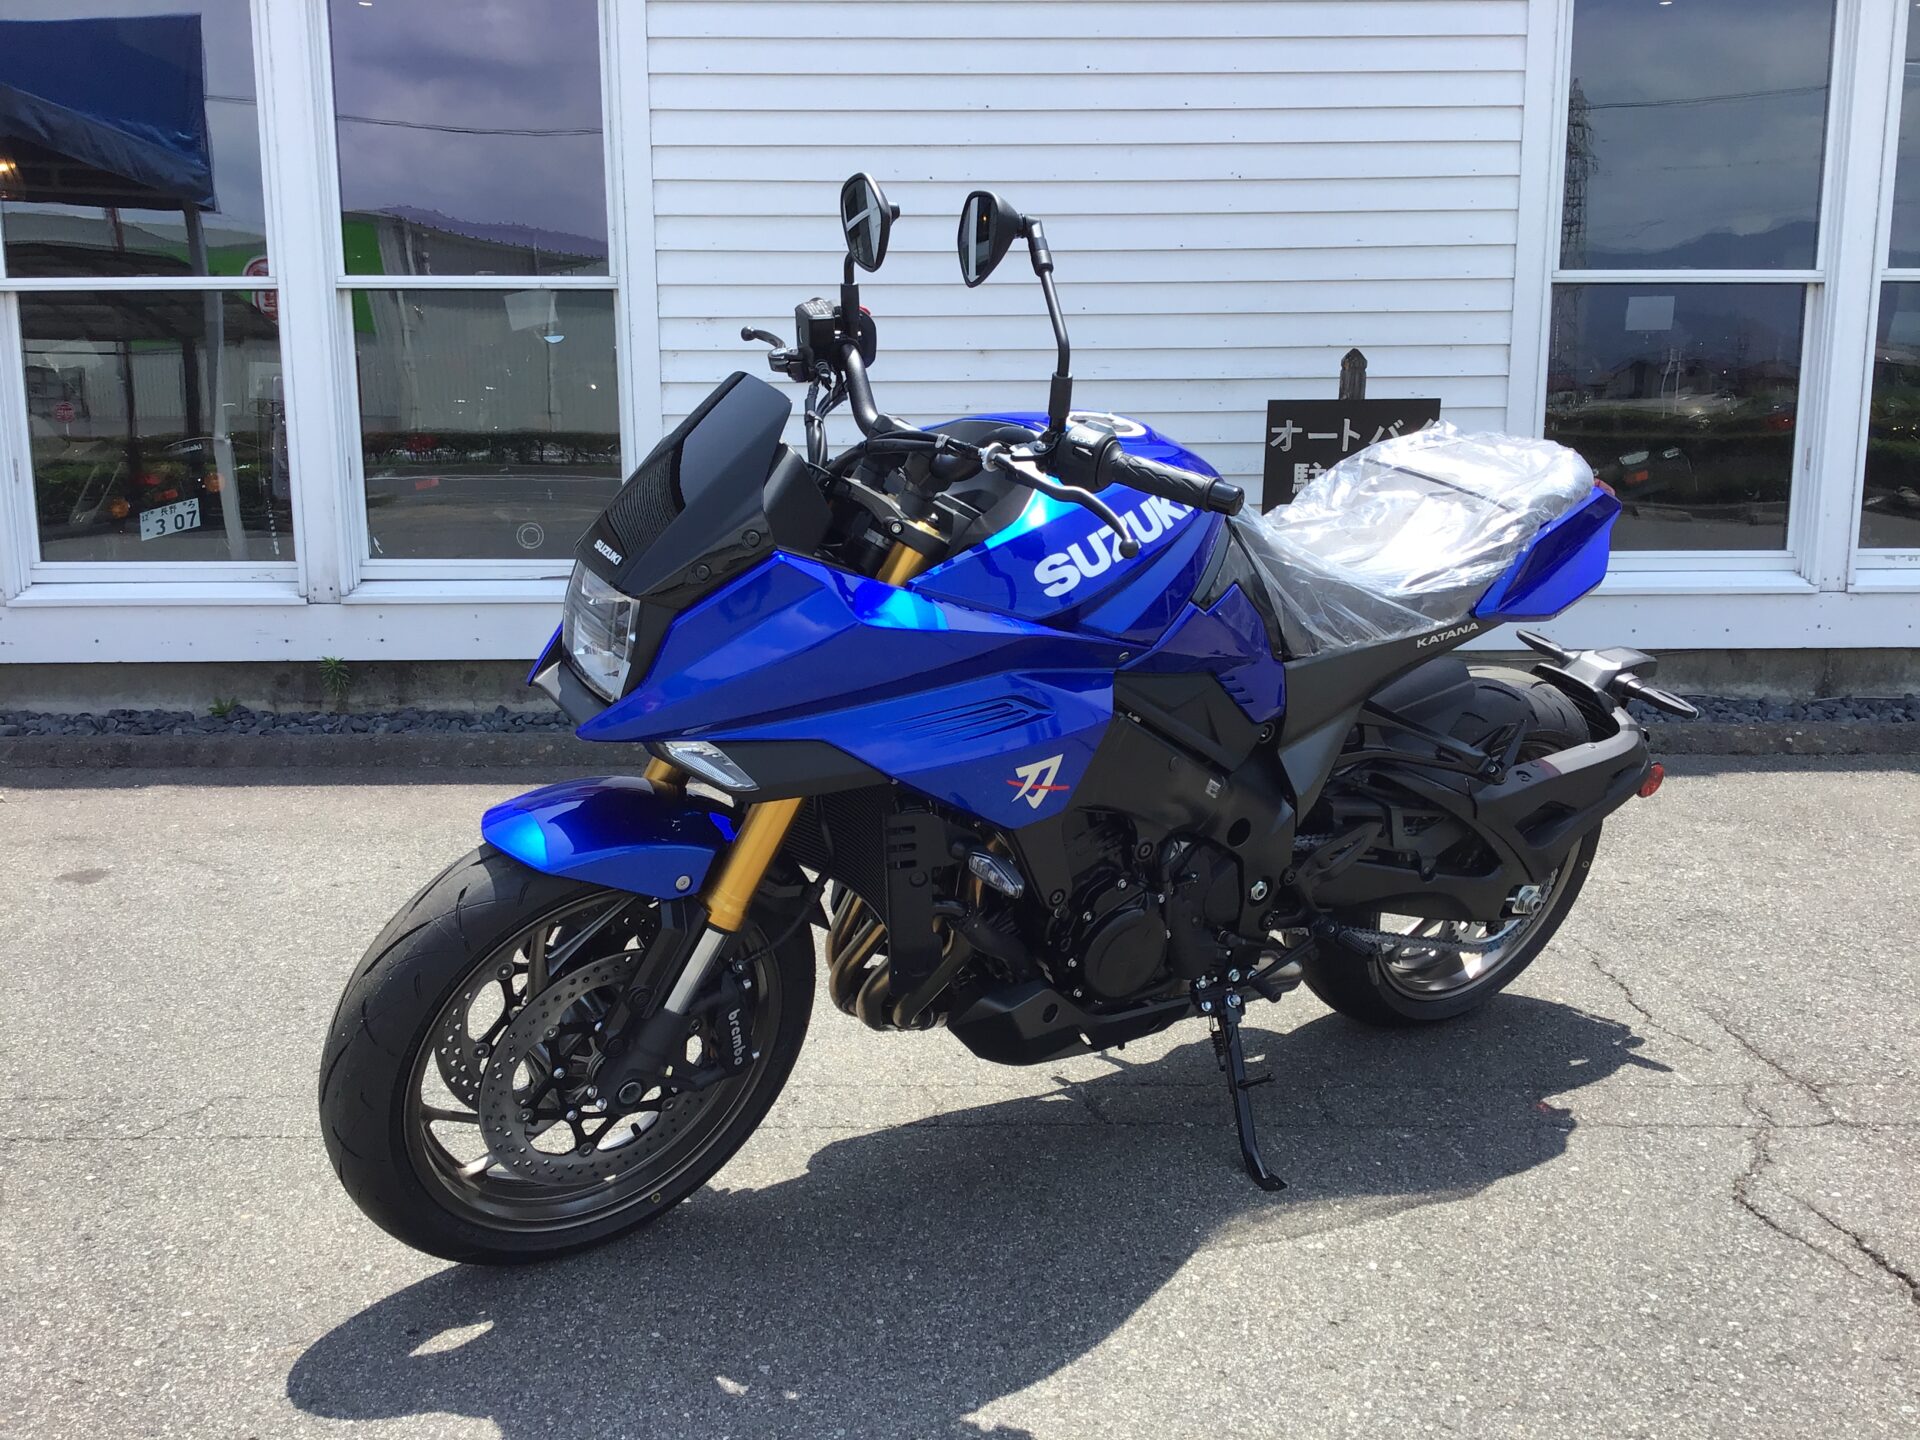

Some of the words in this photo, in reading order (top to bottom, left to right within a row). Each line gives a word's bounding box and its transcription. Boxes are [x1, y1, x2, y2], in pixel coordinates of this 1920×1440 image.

[593, 539, 623, 566] SUZUKI
[1033, 495, 1195, 598] SUZUK
[1416, 622, 1479, 649] KATANA
[728, 1008, 746, 1066] brembo
